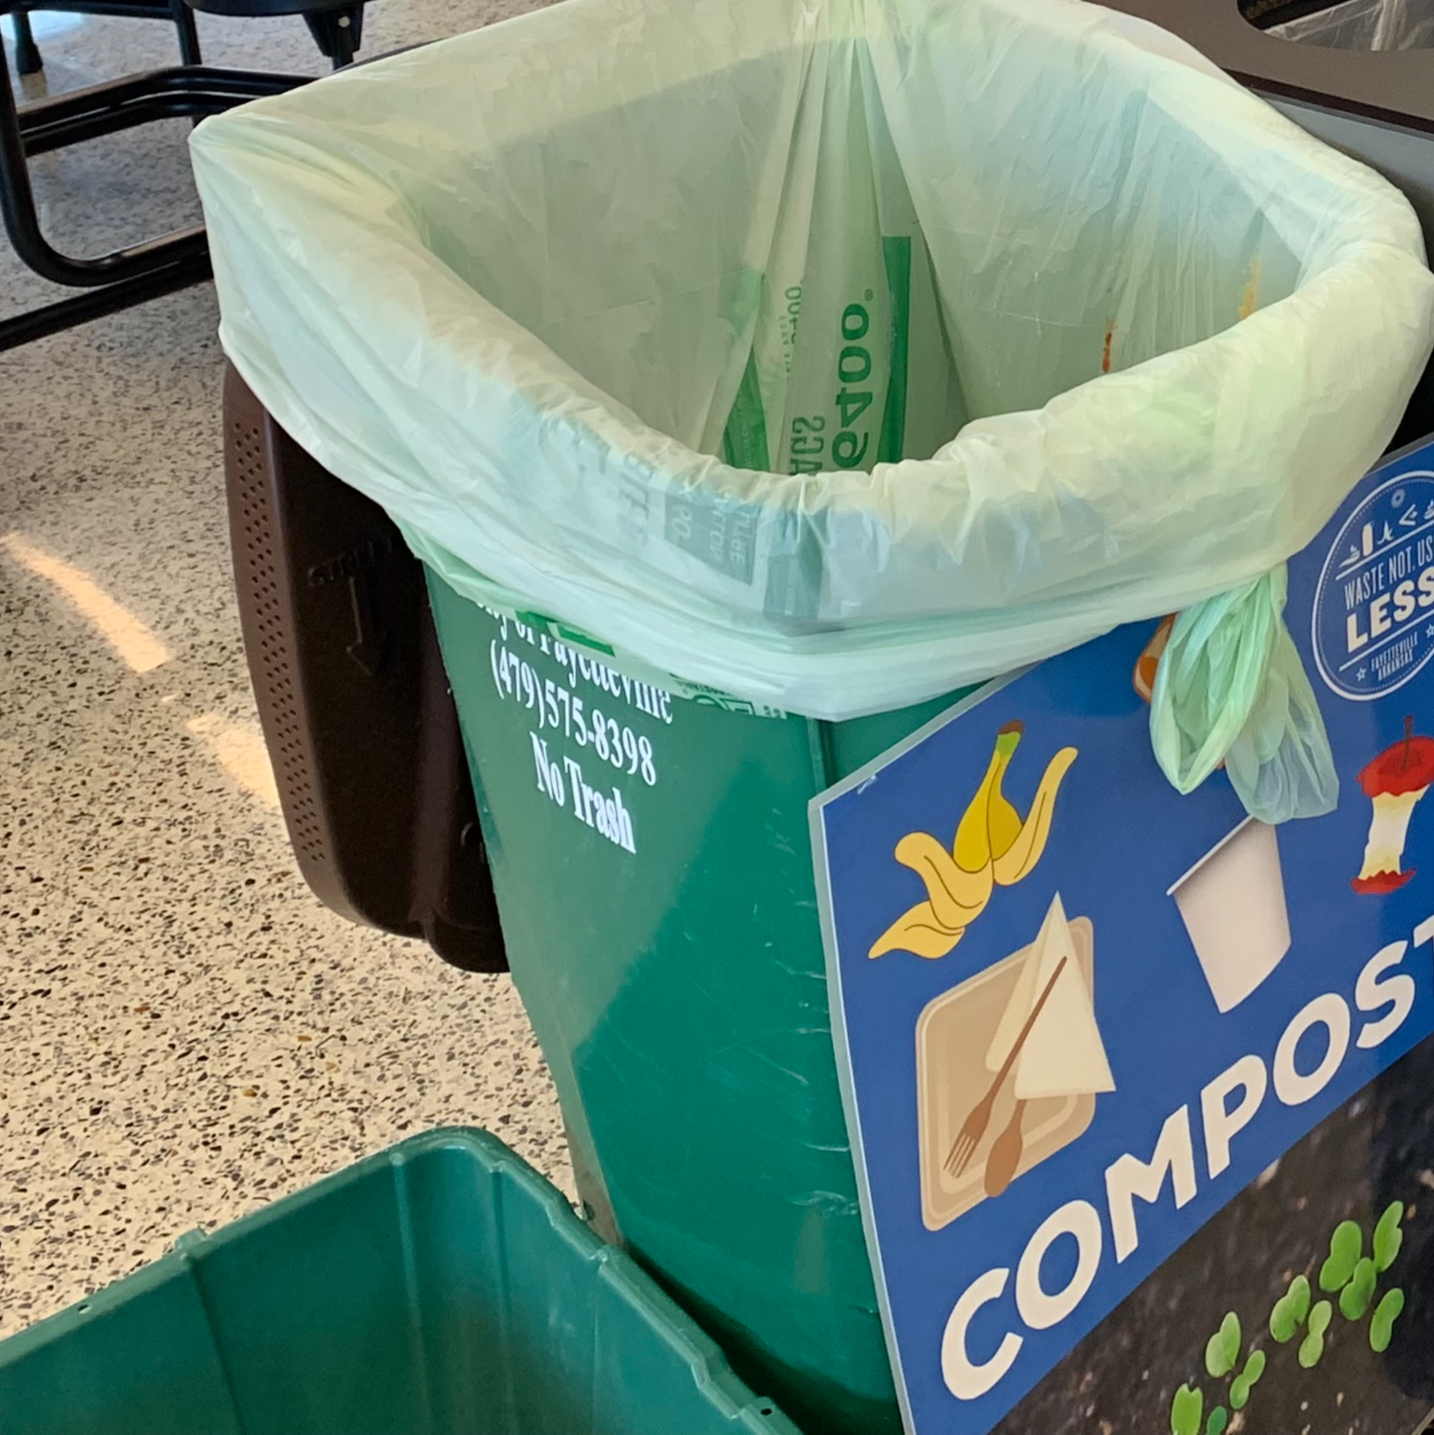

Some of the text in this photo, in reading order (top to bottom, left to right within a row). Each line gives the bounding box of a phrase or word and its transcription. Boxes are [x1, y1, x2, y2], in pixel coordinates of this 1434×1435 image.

[1345, 563, 1385, 611] WASTE
[1371, 631, 1418, 672] FAYETTEVILLE
[1378, 649, 1414, 682] ARKANSAS
[529, 731, 637, 855] No Trash
